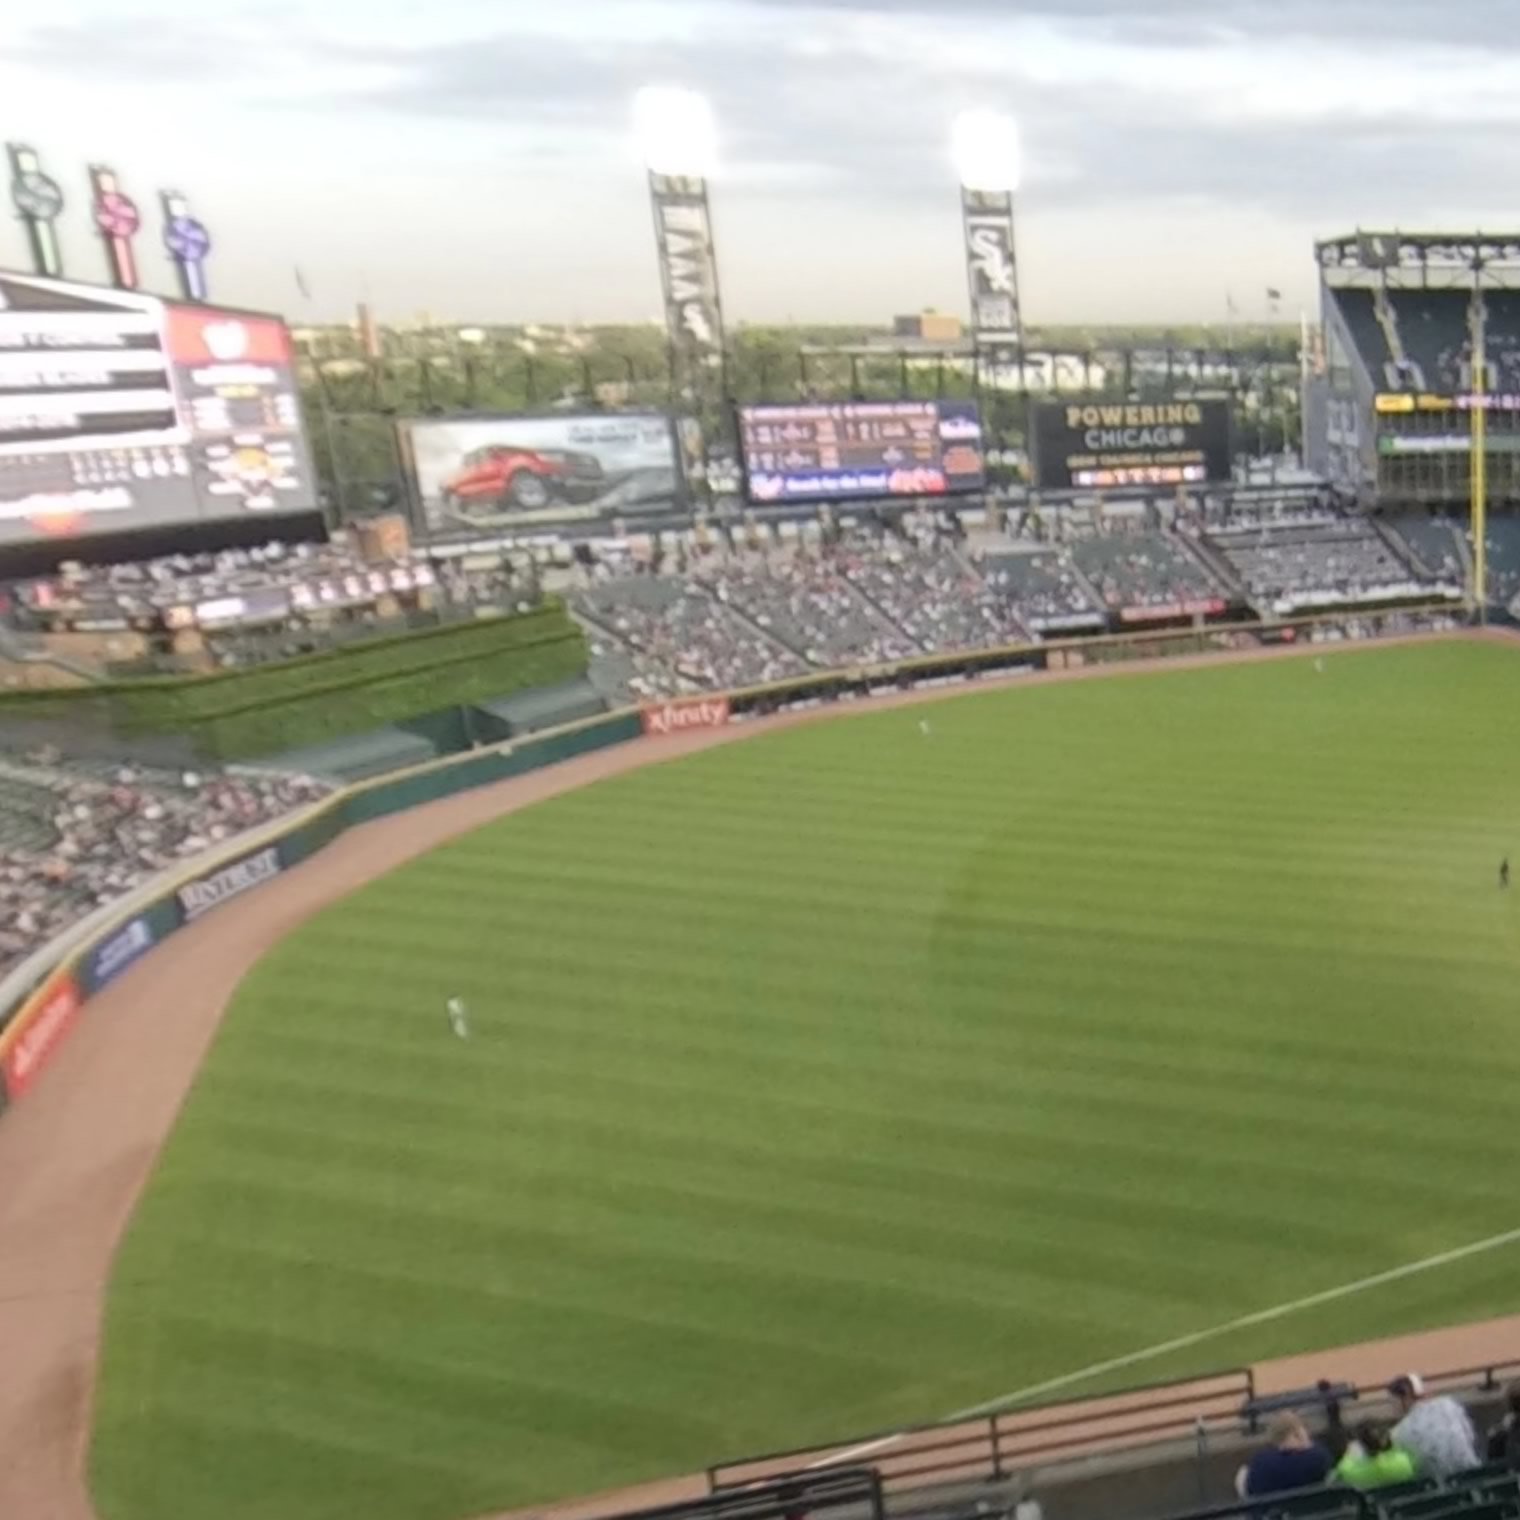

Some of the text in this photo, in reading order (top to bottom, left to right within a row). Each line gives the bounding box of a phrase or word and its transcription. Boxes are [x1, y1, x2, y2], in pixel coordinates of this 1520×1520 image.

[1066, 403, 1202, 428] POWERING
[1085, 427, 1186, 449] CHICAGO
[649, 702, 725, 733] xfinity
